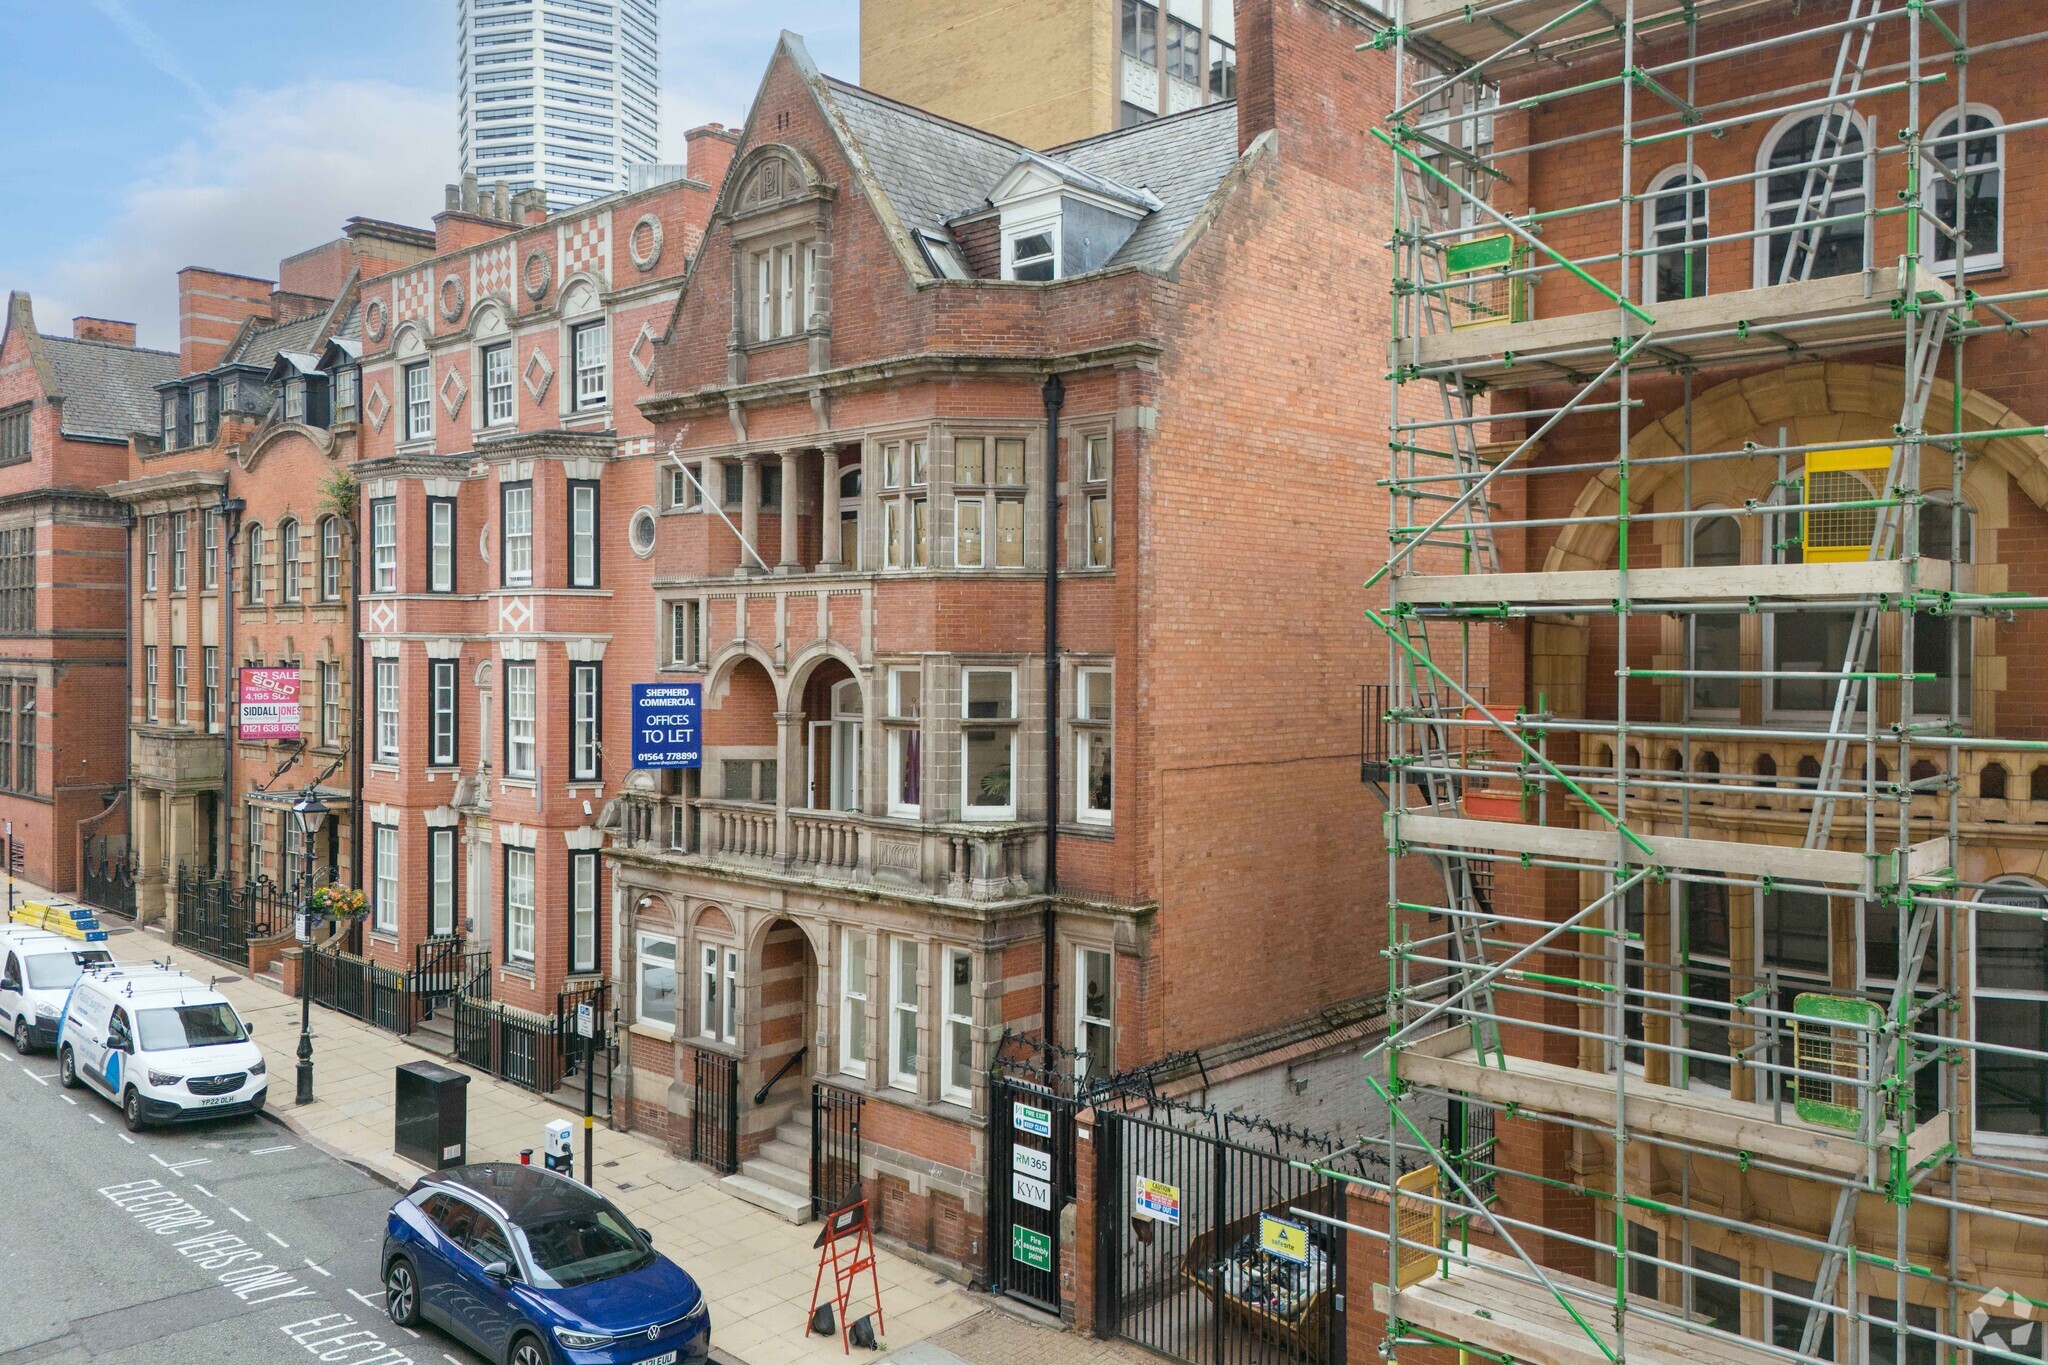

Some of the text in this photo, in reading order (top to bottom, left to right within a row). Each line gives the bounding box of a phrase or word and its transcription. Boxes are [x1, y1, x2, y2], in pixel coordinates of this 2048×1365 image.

[272, 672, 299, 680] SALE
[252, 674, 295, 694] SOLD
[646, 688, 689, 696] SHEPHERD
[640, 698, 696, 706] COMMERCIAL
[244, 706, 277, 716] SIDDALL
[646, 715, 689, 726] OFFICES
[642, 729, 694, 743] TO LET
[638, 752, 663, 761] 01564
[1034, 1124, 1047, 1133] CLEAR
[1017, 1180, 1046, 1202] KYM
[1152, 1182, 1170, 1193] CAUTION
[1151, 1202, 1172, 1214] KEEP OUT
[98, 1179, 316, 1305] ELECTRIC VEHS ONLY
[1030, 1235, 1041, 1245] Fire
[1272, 1239, 1294, 1250] safesite
[1023, 1242, 1048, 1257] assembly
[1029, 1253, 1042, 1262] point
